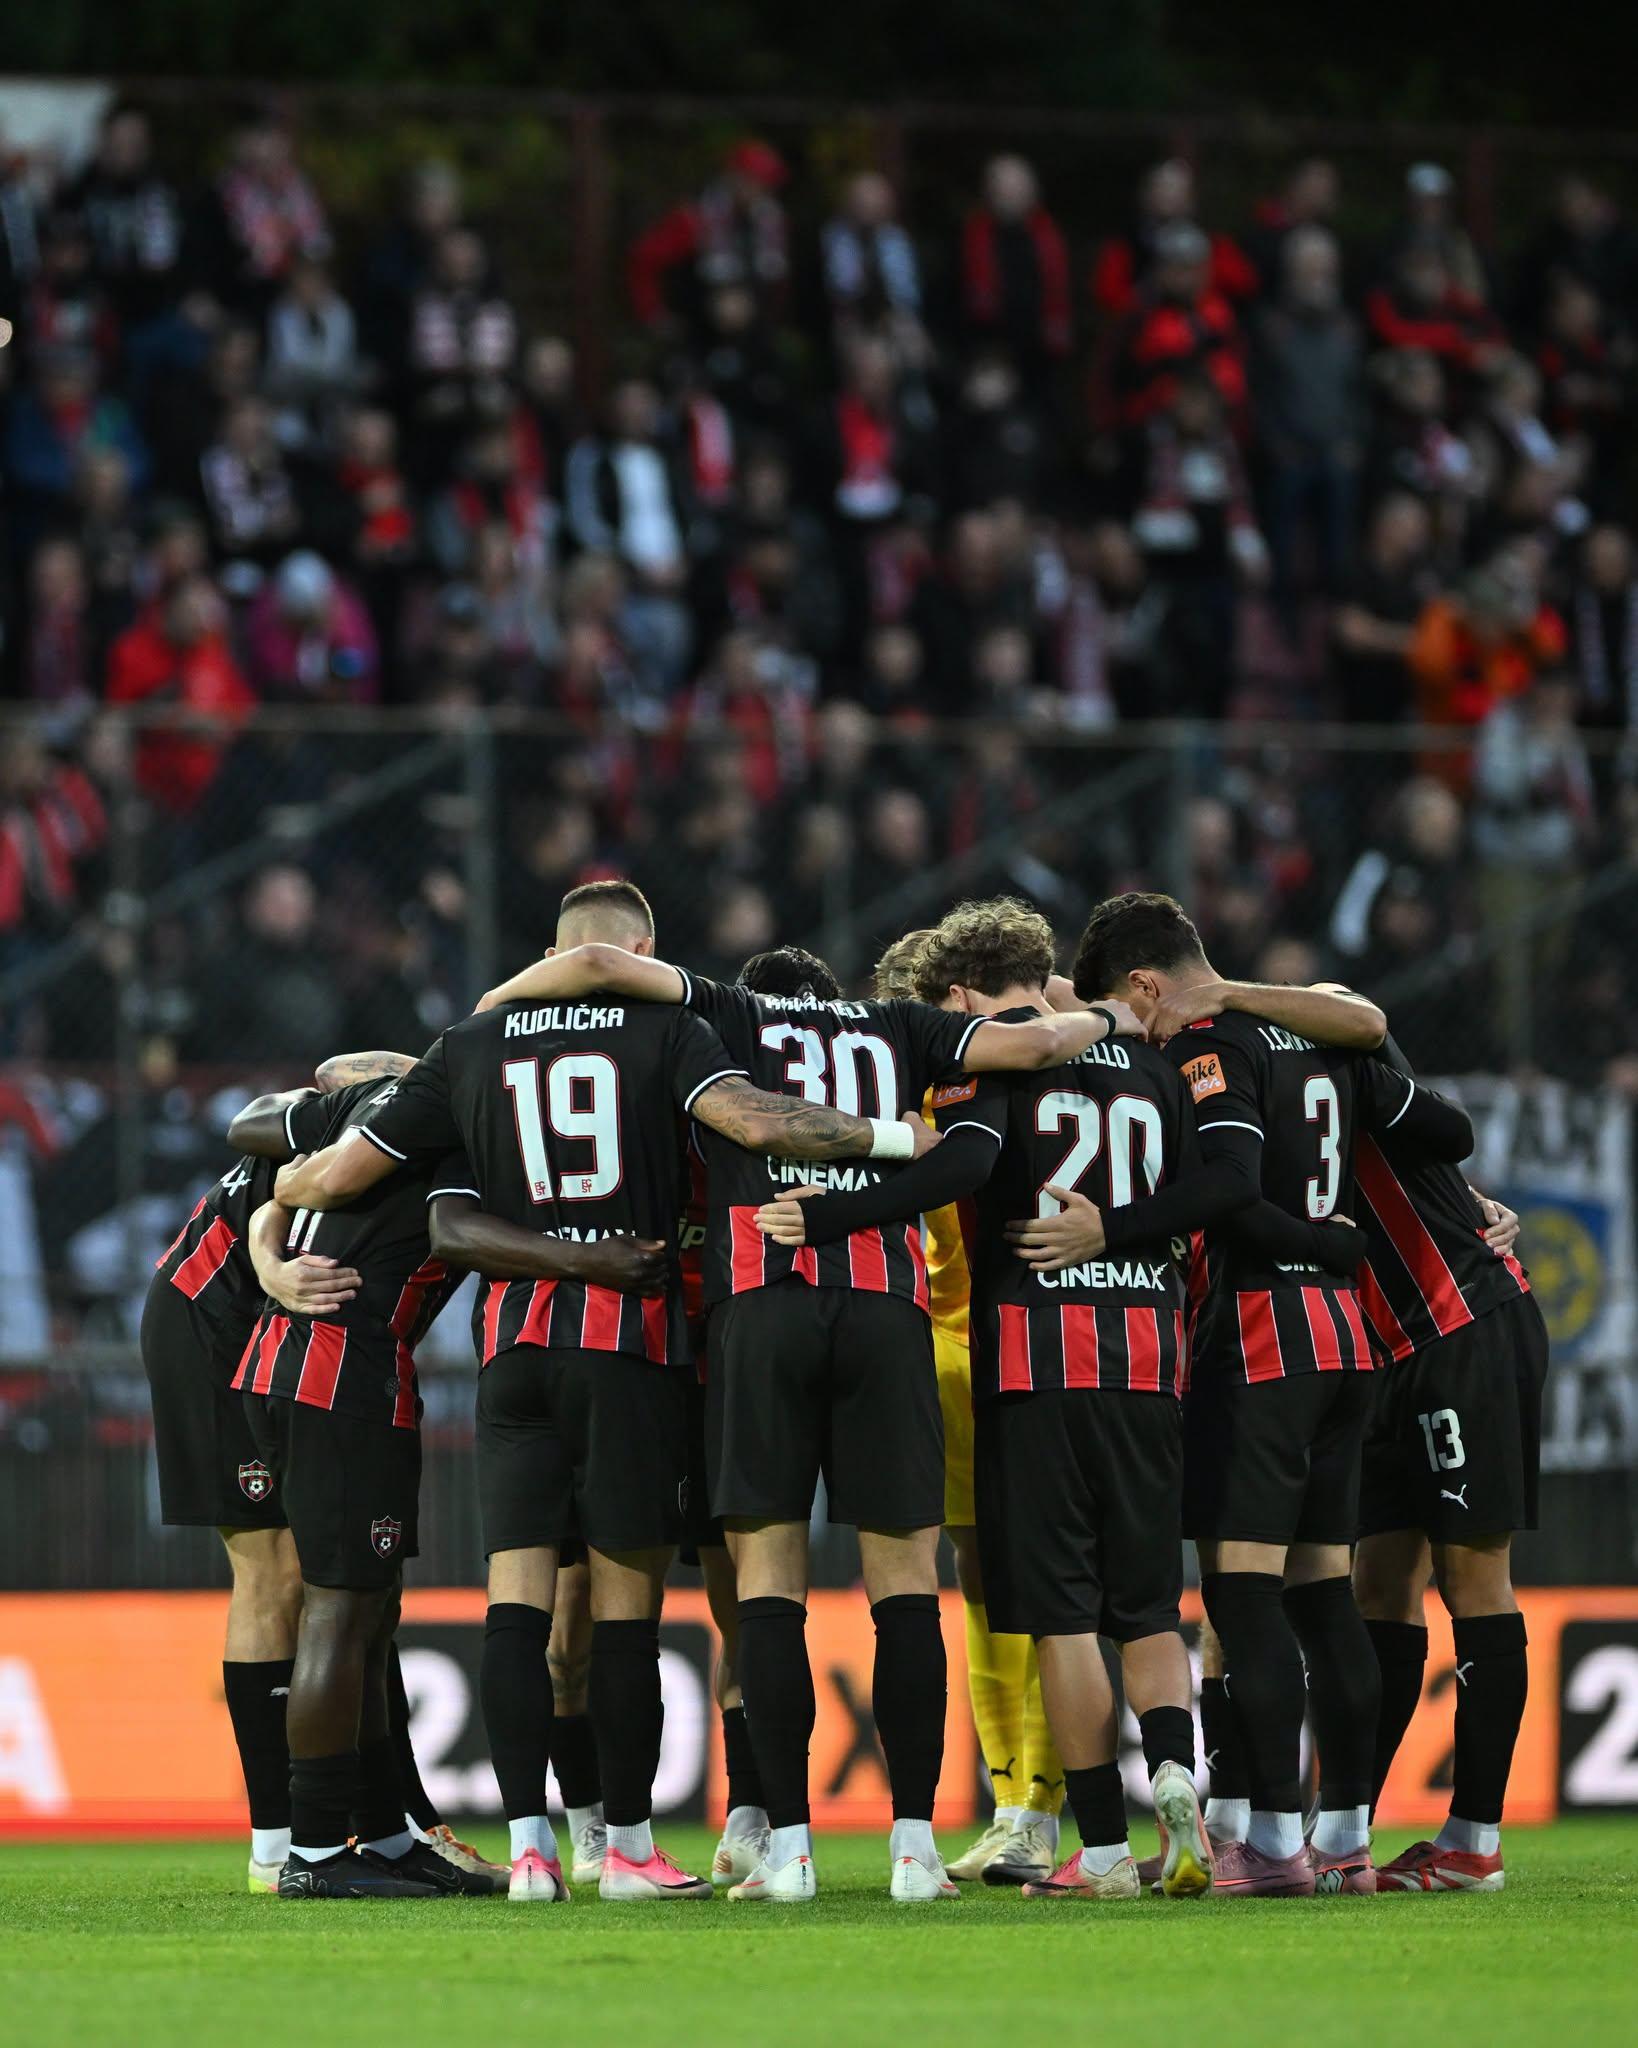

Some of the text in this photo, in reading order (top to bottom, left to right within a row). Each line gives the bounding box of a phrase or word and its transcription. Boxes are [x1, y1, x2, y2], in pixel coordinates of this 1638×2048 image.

[504, 1004, 624, 1038] KUDLIČKA
[759, 1023, 898, 1120] 30
[502, 1052, 624, 1205] 19
[767, 1155, 881, 1192] CINEMA
[1035, 1088, 1165, 1219] 20
[1303, 1074, 1341, 1222] 3
[1037, 1261, 1168, 1291] CINEMAX
[1418, 1408, 1466, 1472] 13
[826, 1662, 893, 1799] X
[1565, 1644, 1638, 1806] 2
